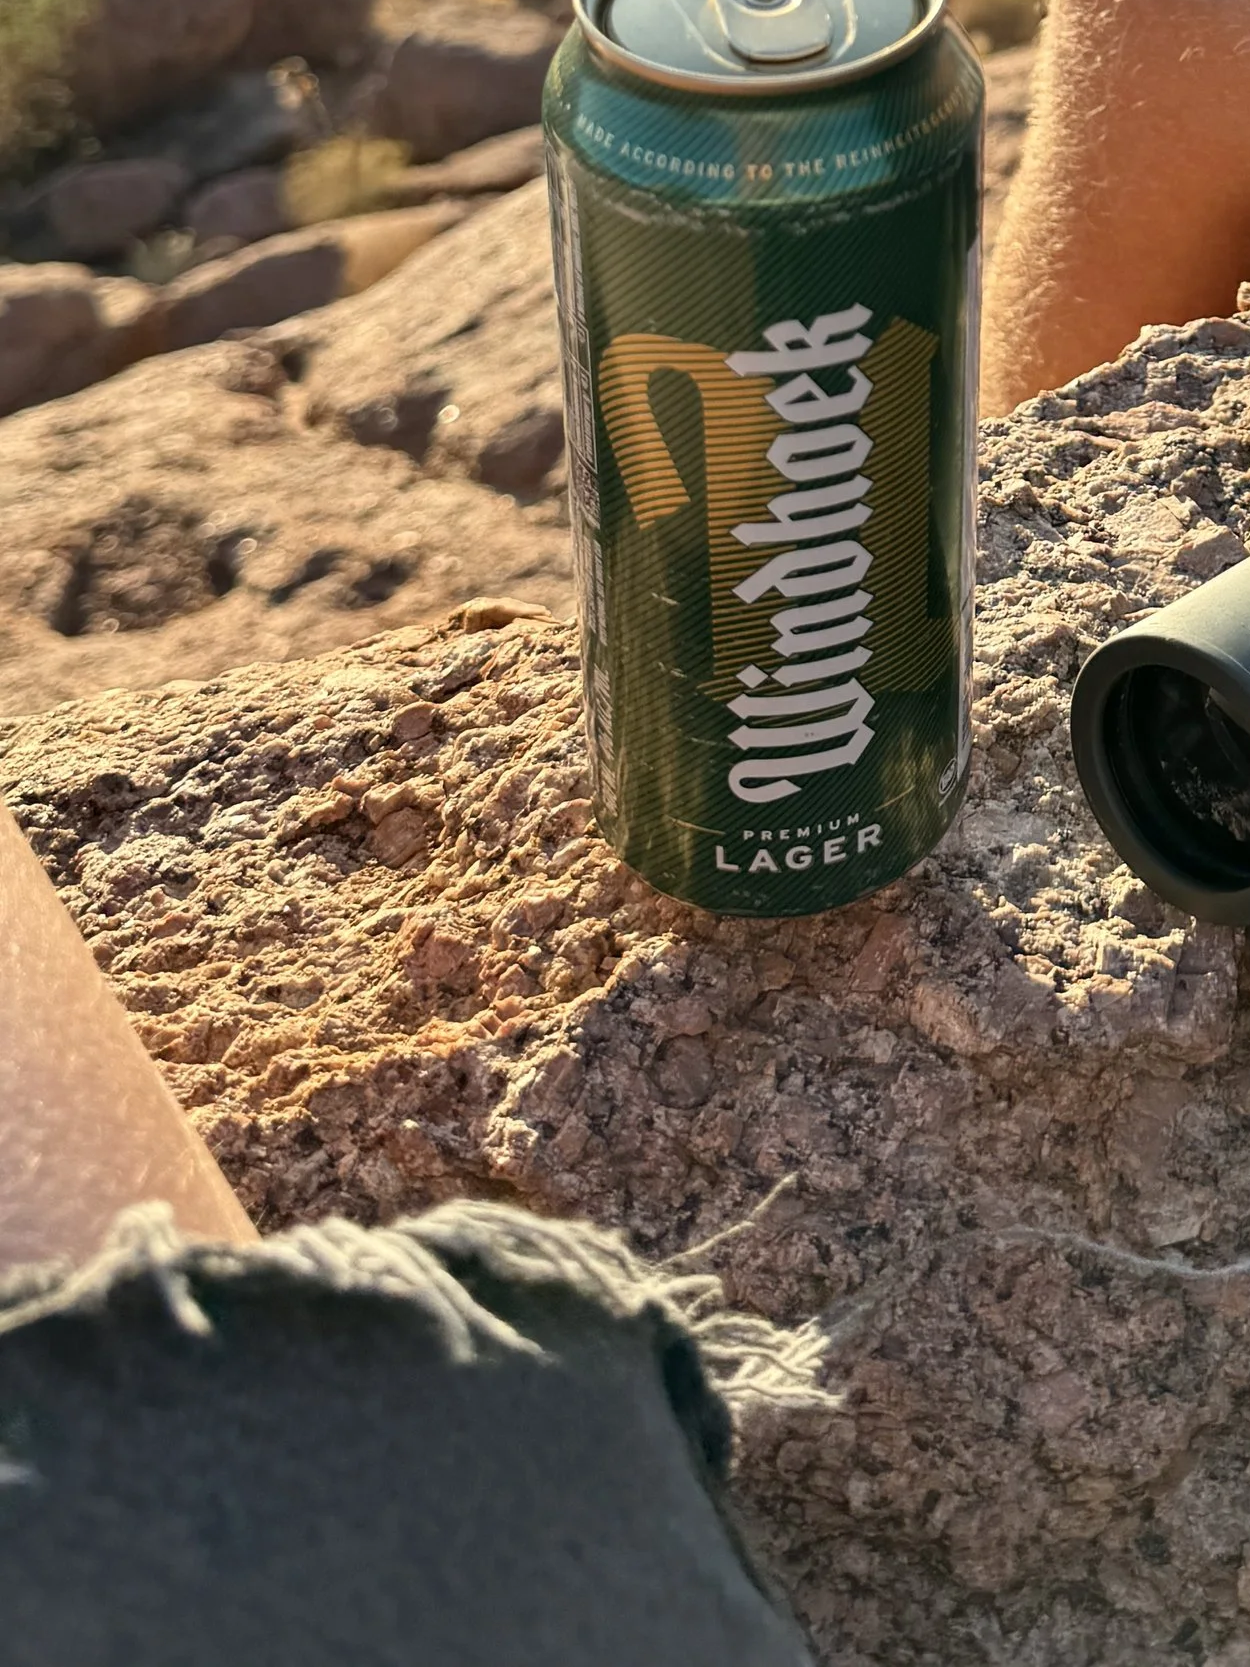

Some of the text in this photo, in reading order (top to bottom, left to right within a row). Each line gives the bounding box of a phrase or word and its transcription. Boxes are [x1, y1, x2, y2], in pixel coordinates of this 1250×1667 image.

[575, 112, 616, 149] MADE
[620, 141, 736, 181] ACCORDING
[746, 163, 773, 182] TO
[784, 157, 825, 179] THE
[724, 301, 876, 804] Windhoek
[715, 823, 884, 873] LAGER
[743, 812, 861, 842] PREMIUM
